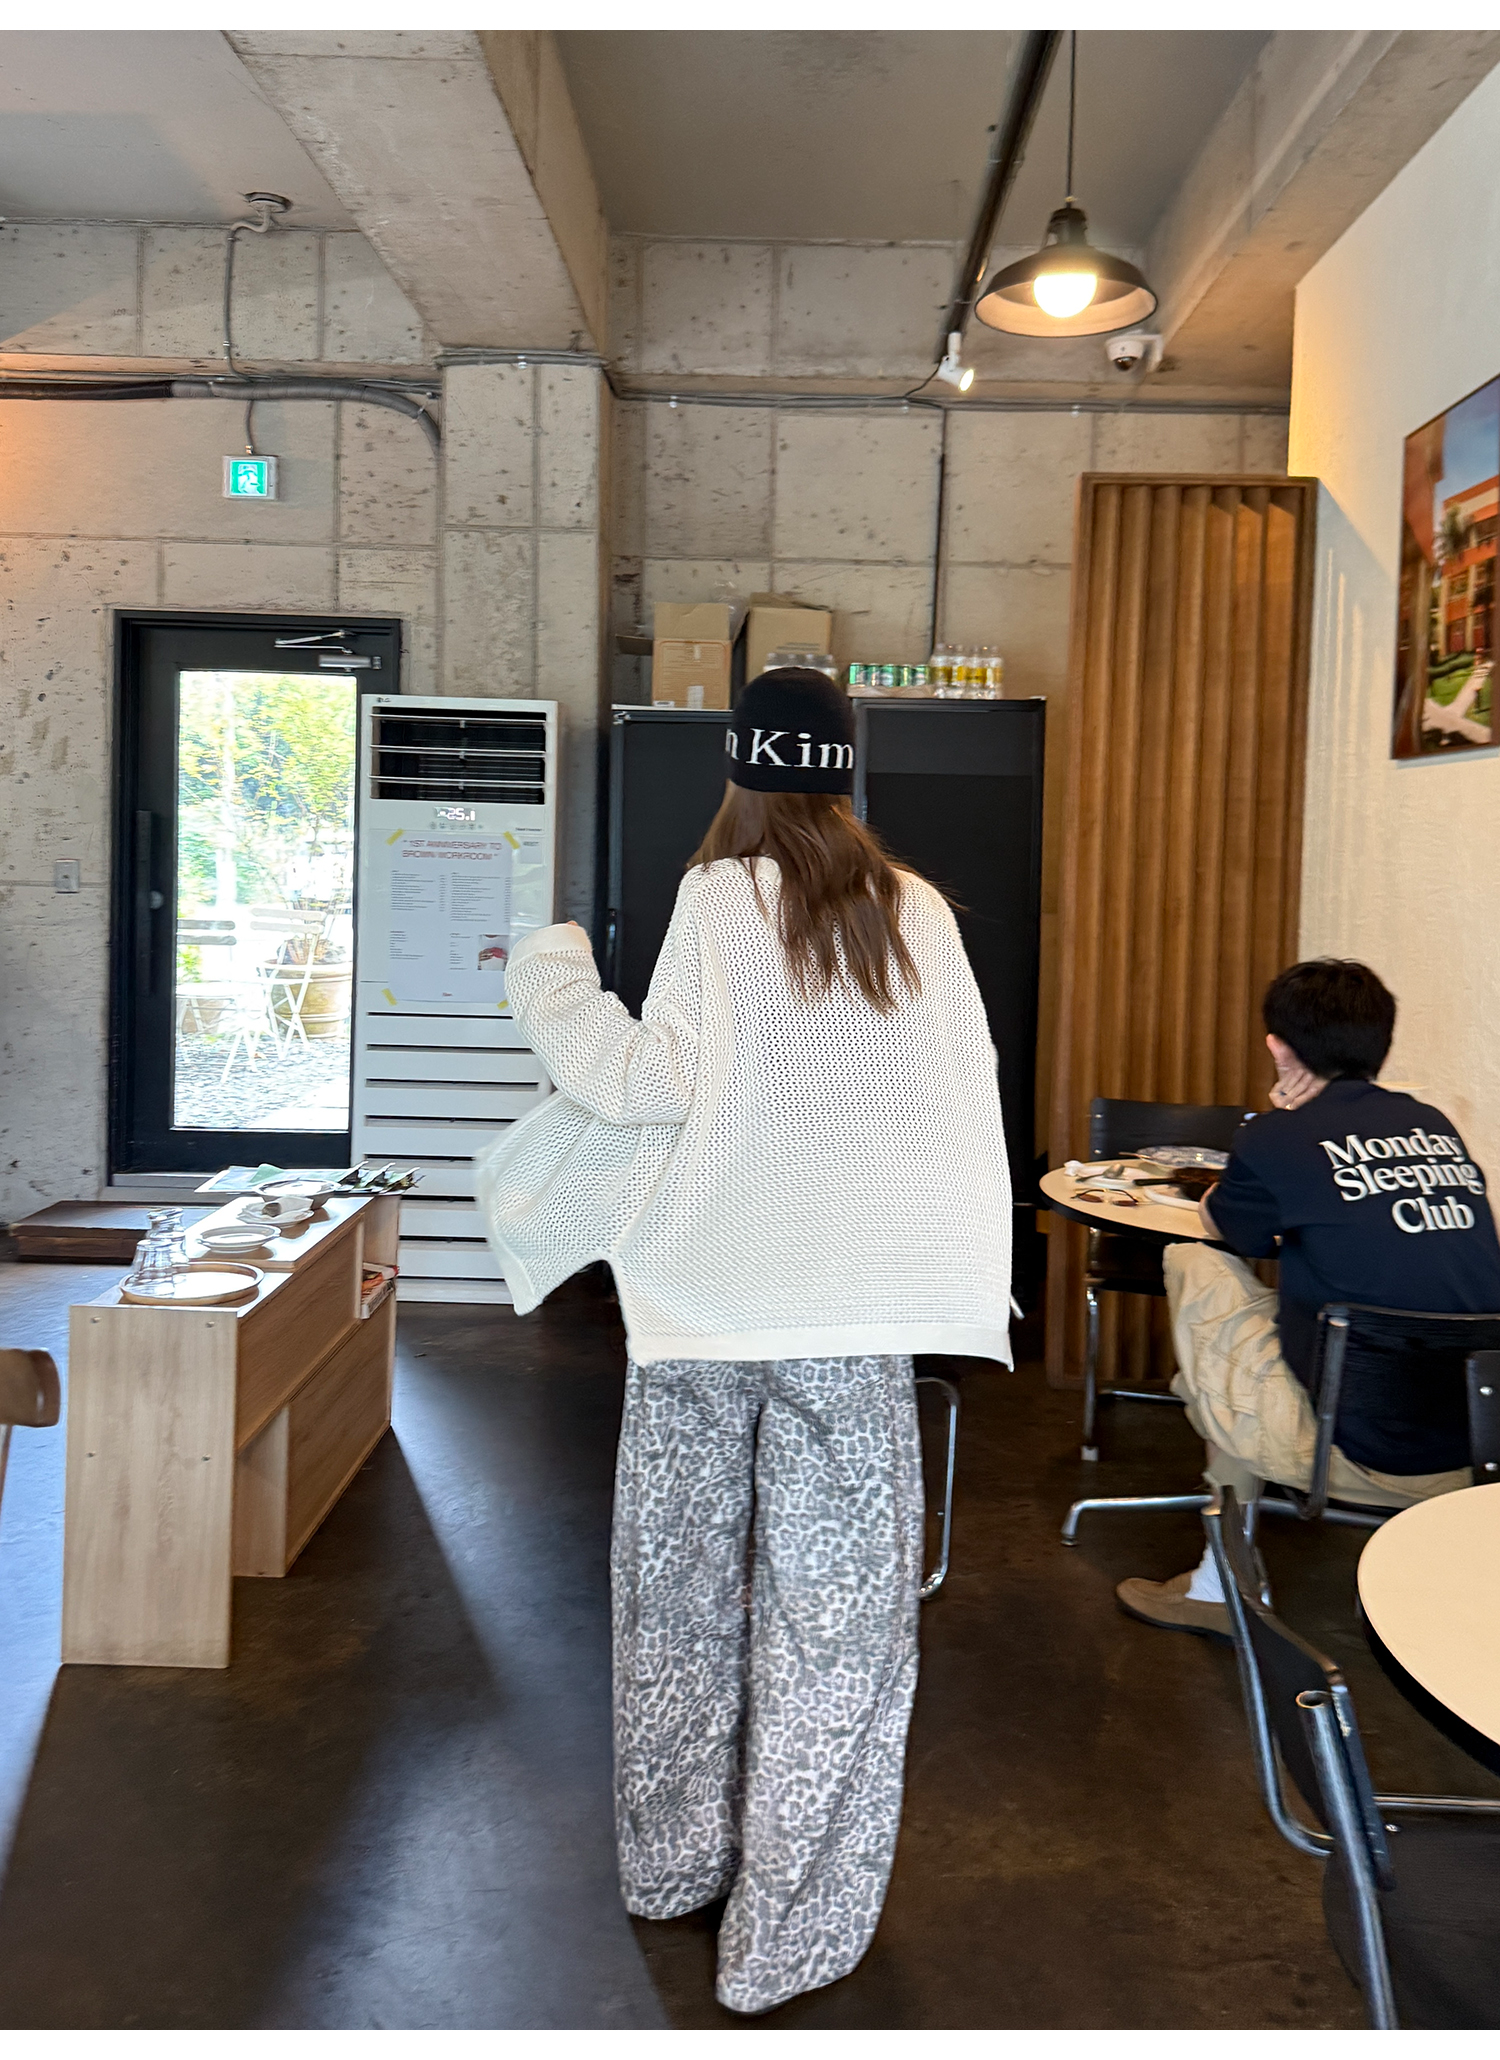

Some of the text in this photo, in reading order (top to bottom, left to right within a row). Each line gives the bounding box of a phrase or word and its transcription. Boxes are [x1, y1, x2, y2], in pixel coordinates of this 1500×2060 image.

[746, 728, 855, 769] Kim
[1318, 1128, 1465, 1170] Monday
[1333, 1157, 1486, 1201] Sleeping
[1391, 1195, 1475, 1234] Club
